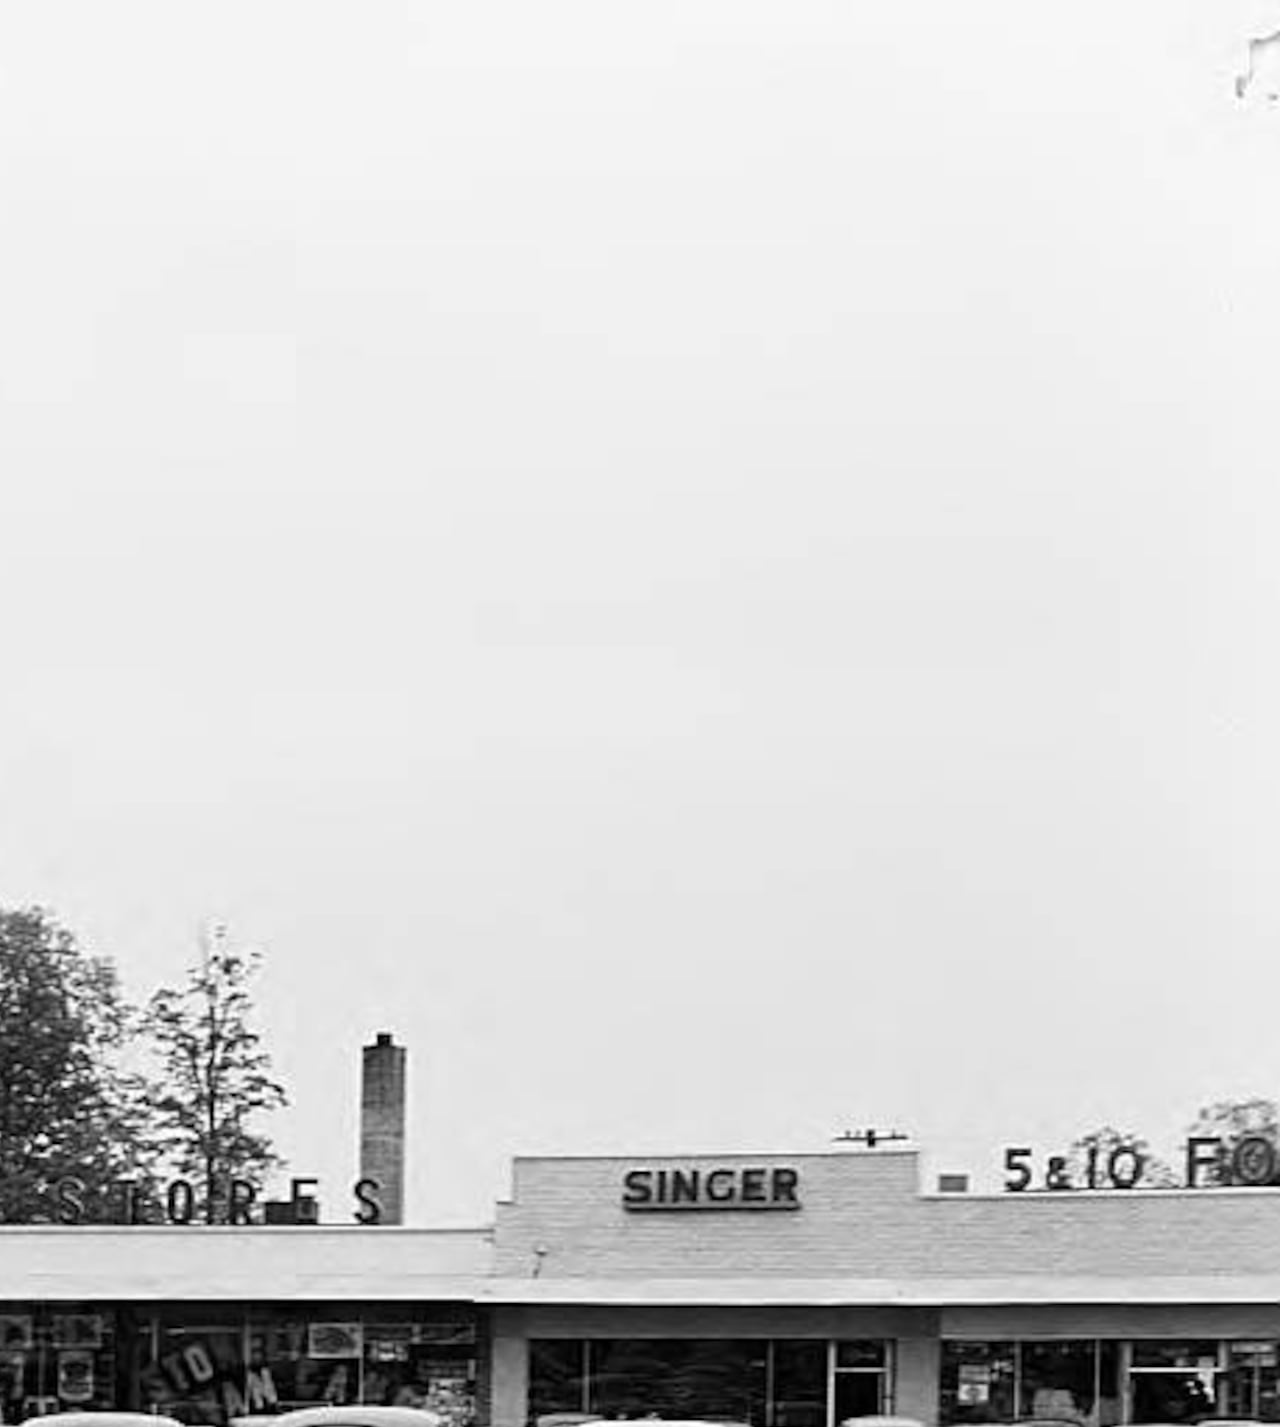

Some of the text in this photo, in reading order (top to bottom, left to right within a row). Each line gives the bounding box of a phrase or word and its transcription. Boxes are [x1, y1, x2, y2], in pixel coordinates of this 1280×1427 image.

[623, 1167, 801, 1204] SINGER
[1004, 1136, 1276, 1192] 5 & 10 FO
[57, 1176, 384, 1225] STORES
